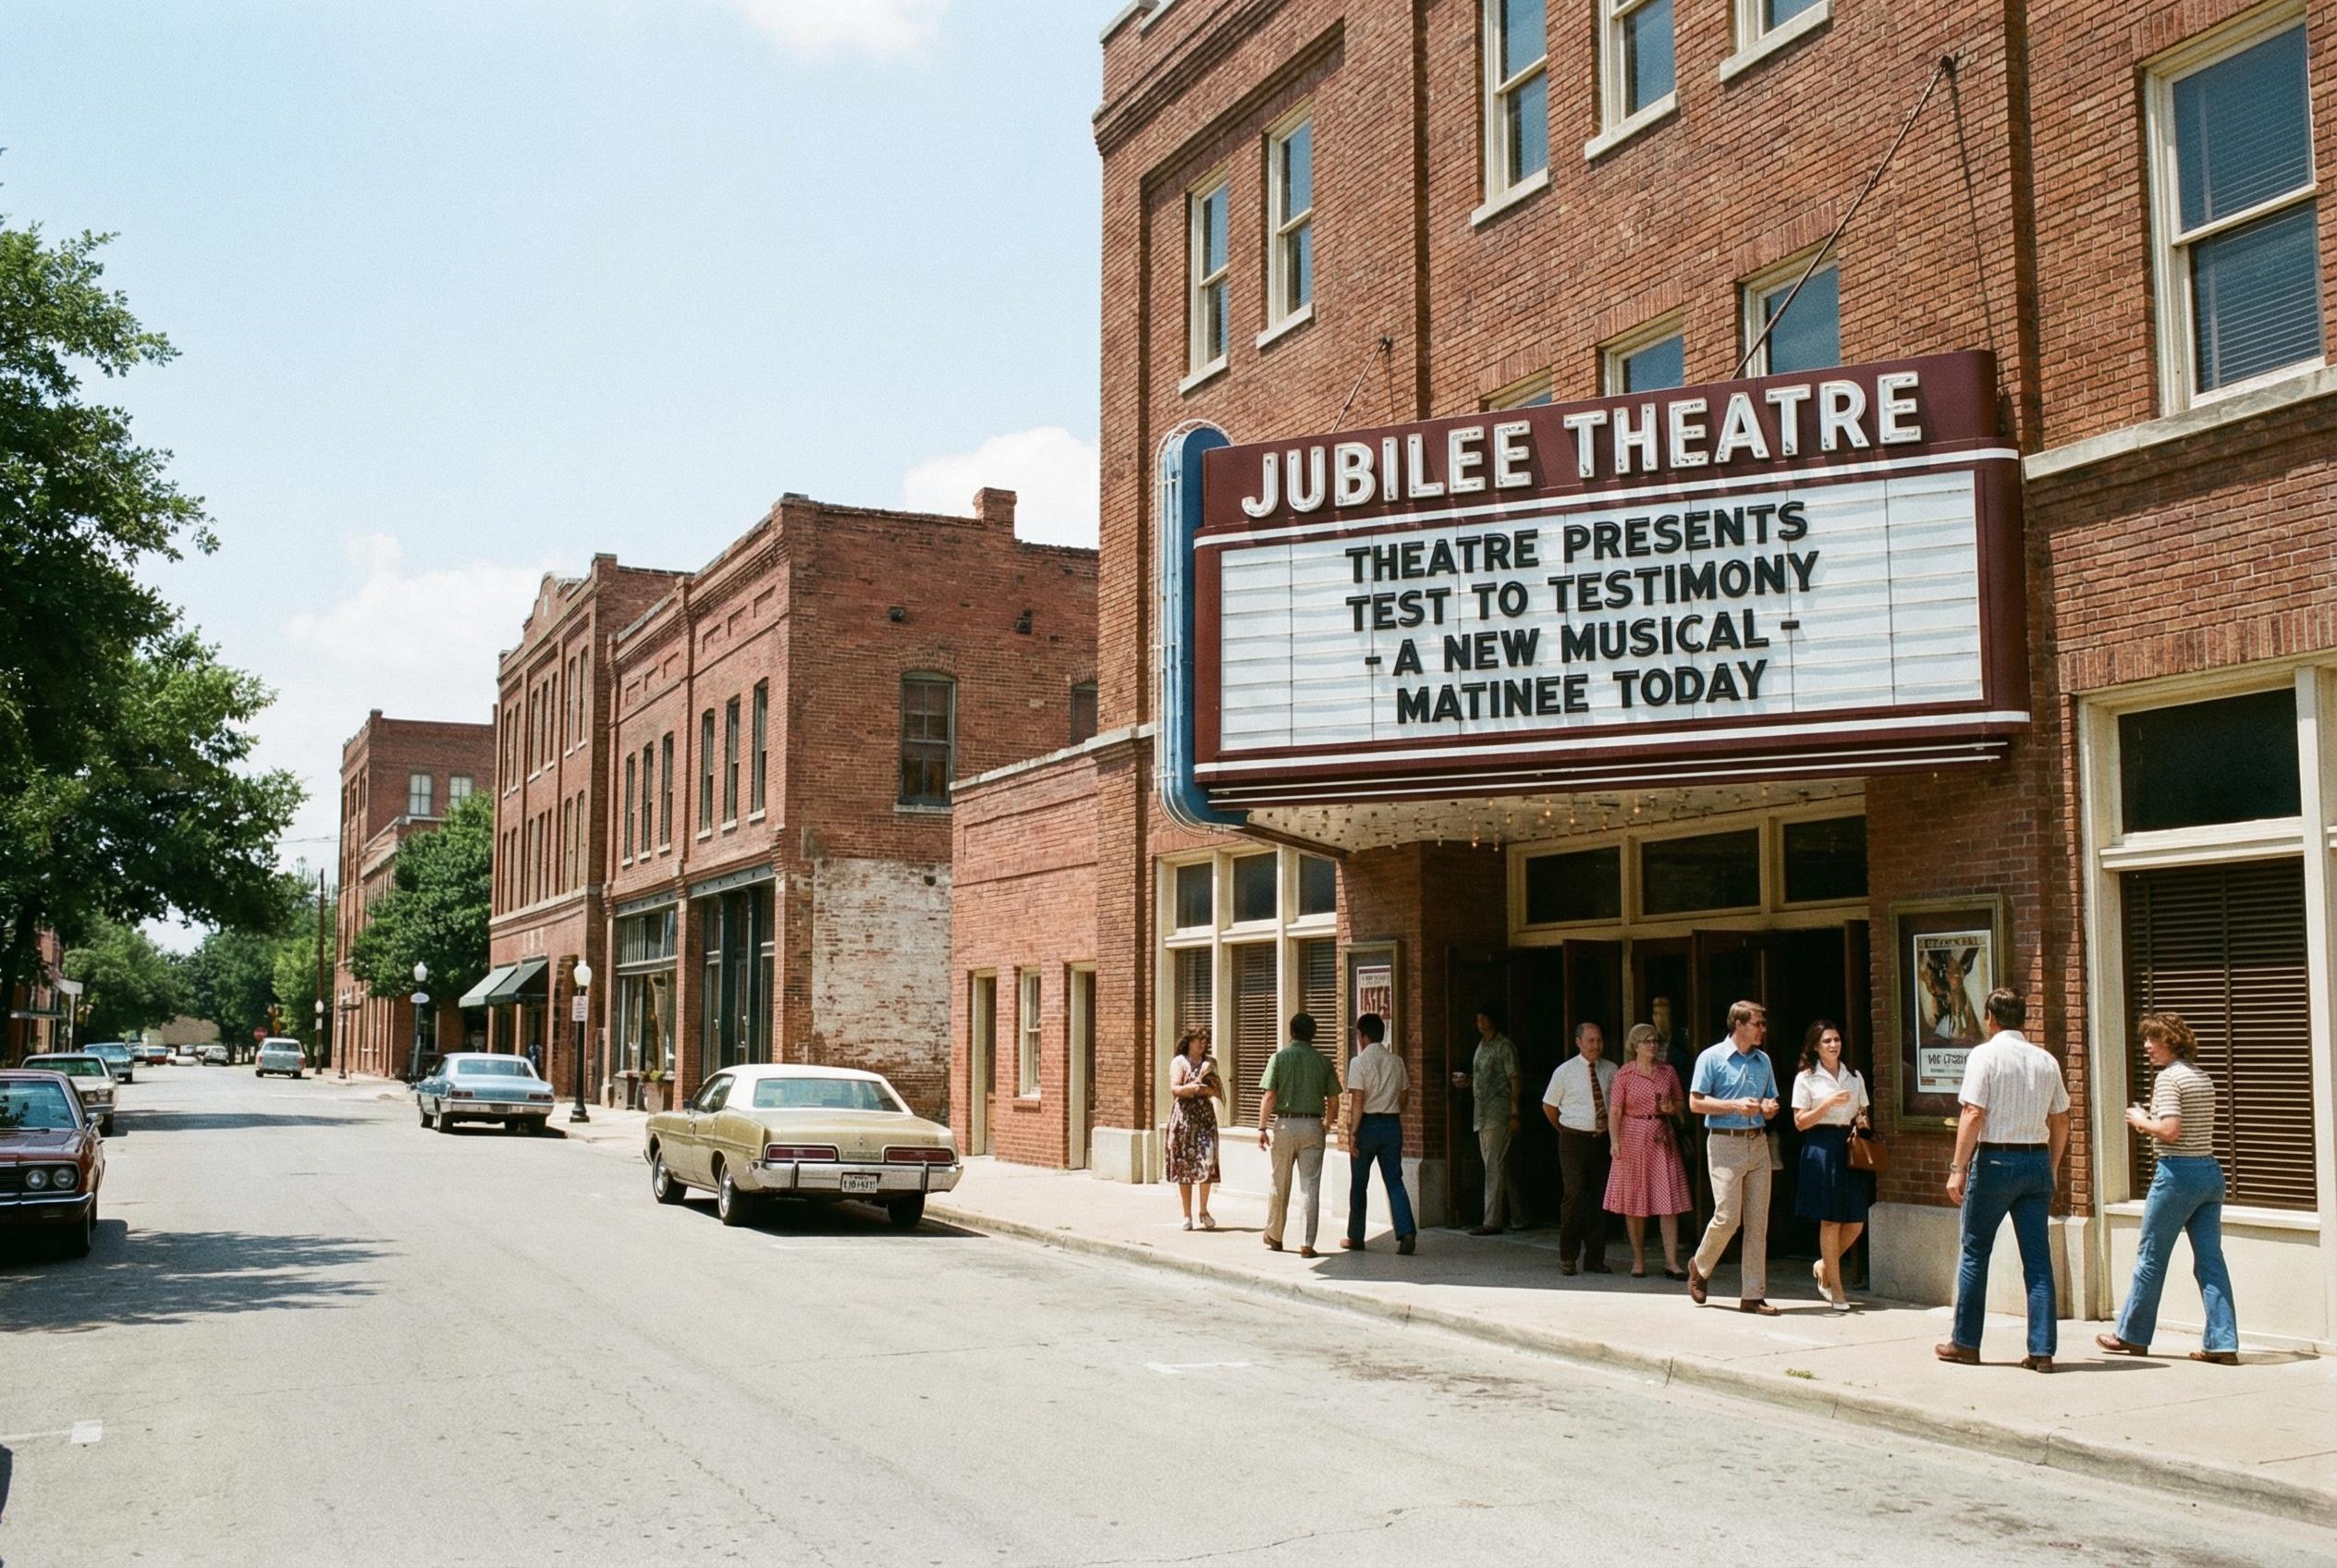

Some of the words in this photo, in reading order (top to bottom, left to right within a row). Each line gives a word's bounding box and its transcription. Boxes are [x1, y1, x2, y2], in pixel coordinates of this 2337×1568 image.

[1241, 420, 1532, 518] JUBILEE
[1563, 371, 1922, 478] THEATRE
[1345, 529, 1539, 584] THEATRE
[1563, 500, 1808, 564] PRESENTS
[1345, 587, 1451, 632] TEST
[1471, 581, 1529, 620] TO
[1548, 550, 1819, 615] TESTIMONY
[1444, 628, 1540, 673] NEW
[1397, 673, 1589, 726] MATINEE
[1612, 658, 1768, 709] TODAY
